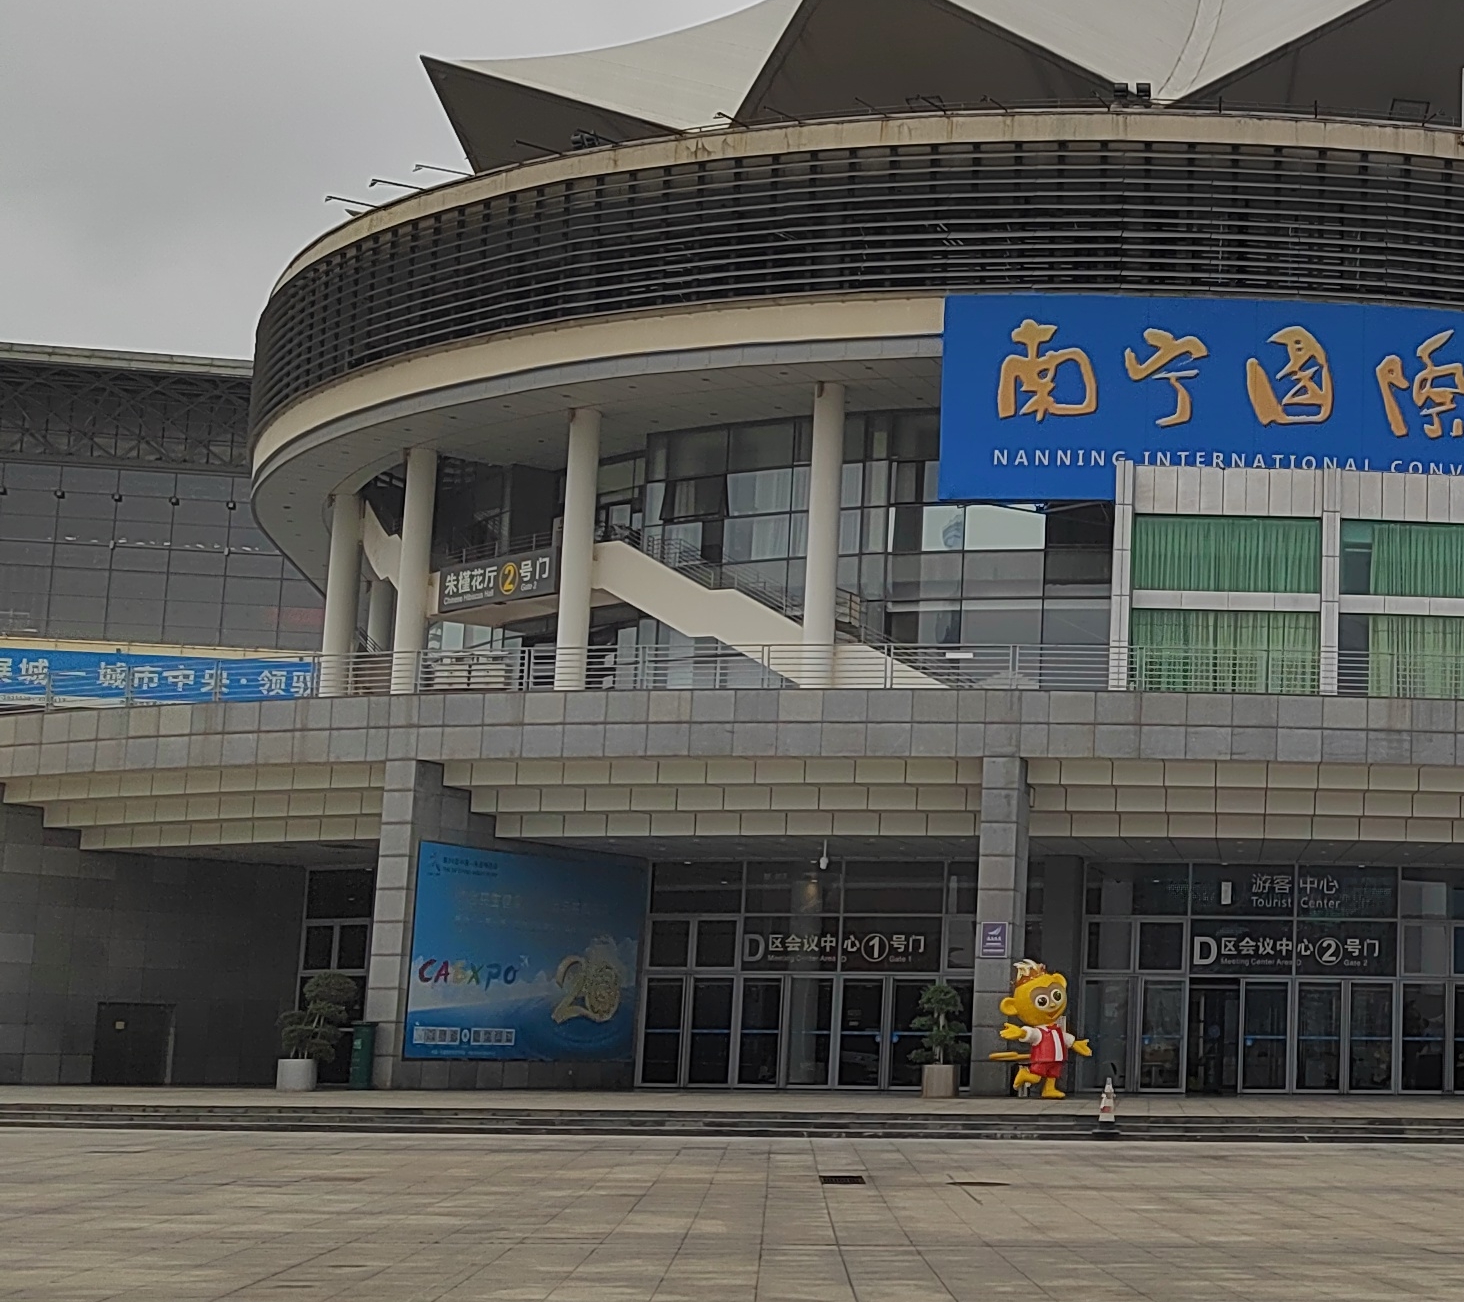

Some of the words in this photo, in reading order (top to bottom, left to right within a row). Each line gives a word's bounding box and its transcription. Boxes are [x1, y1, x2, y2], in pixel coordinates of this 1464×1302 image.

[993, 449, 1126, 467] NANNING
[1251, 873, 1339, 895] 游客中心
[1251, 896, 1292, 908] Tourist
[1301, 897, 1341, 909] Center
[1343, 958, 1361, 967] Gate
[418, 958, 519, 992] CAEXPO
